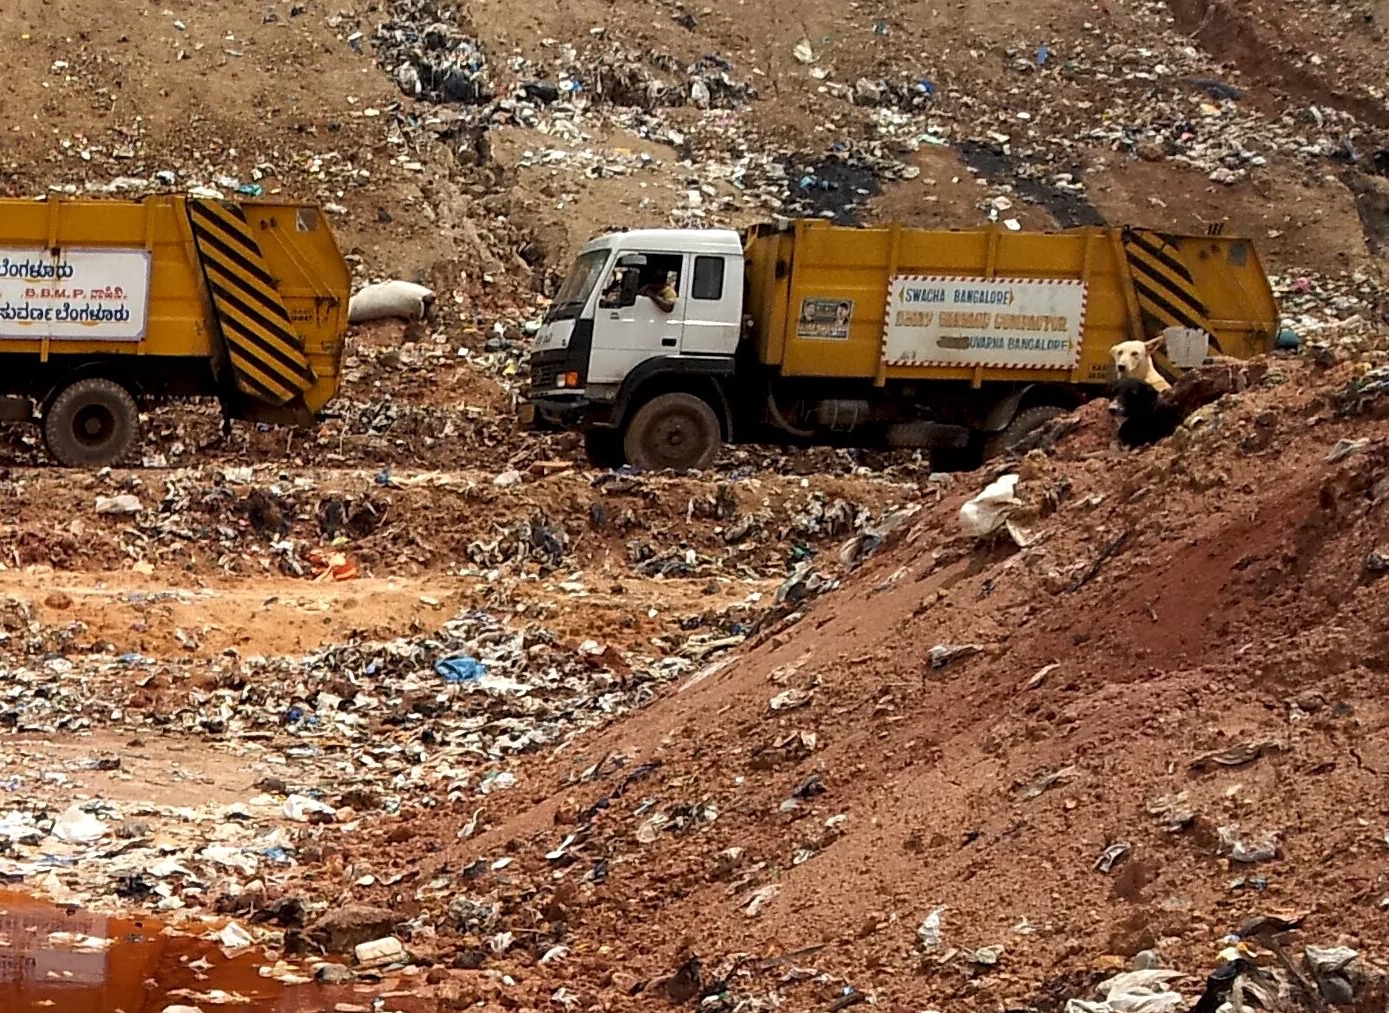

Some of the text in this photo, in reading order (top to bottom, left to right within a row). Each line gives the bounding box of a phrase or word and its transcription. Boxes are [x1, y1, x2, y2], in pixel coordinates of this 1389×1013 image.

[905, 288, 1010, 304] SWACHA BANGALORE
[969, 336, 1068, 351] UVARNA BANGALORE
